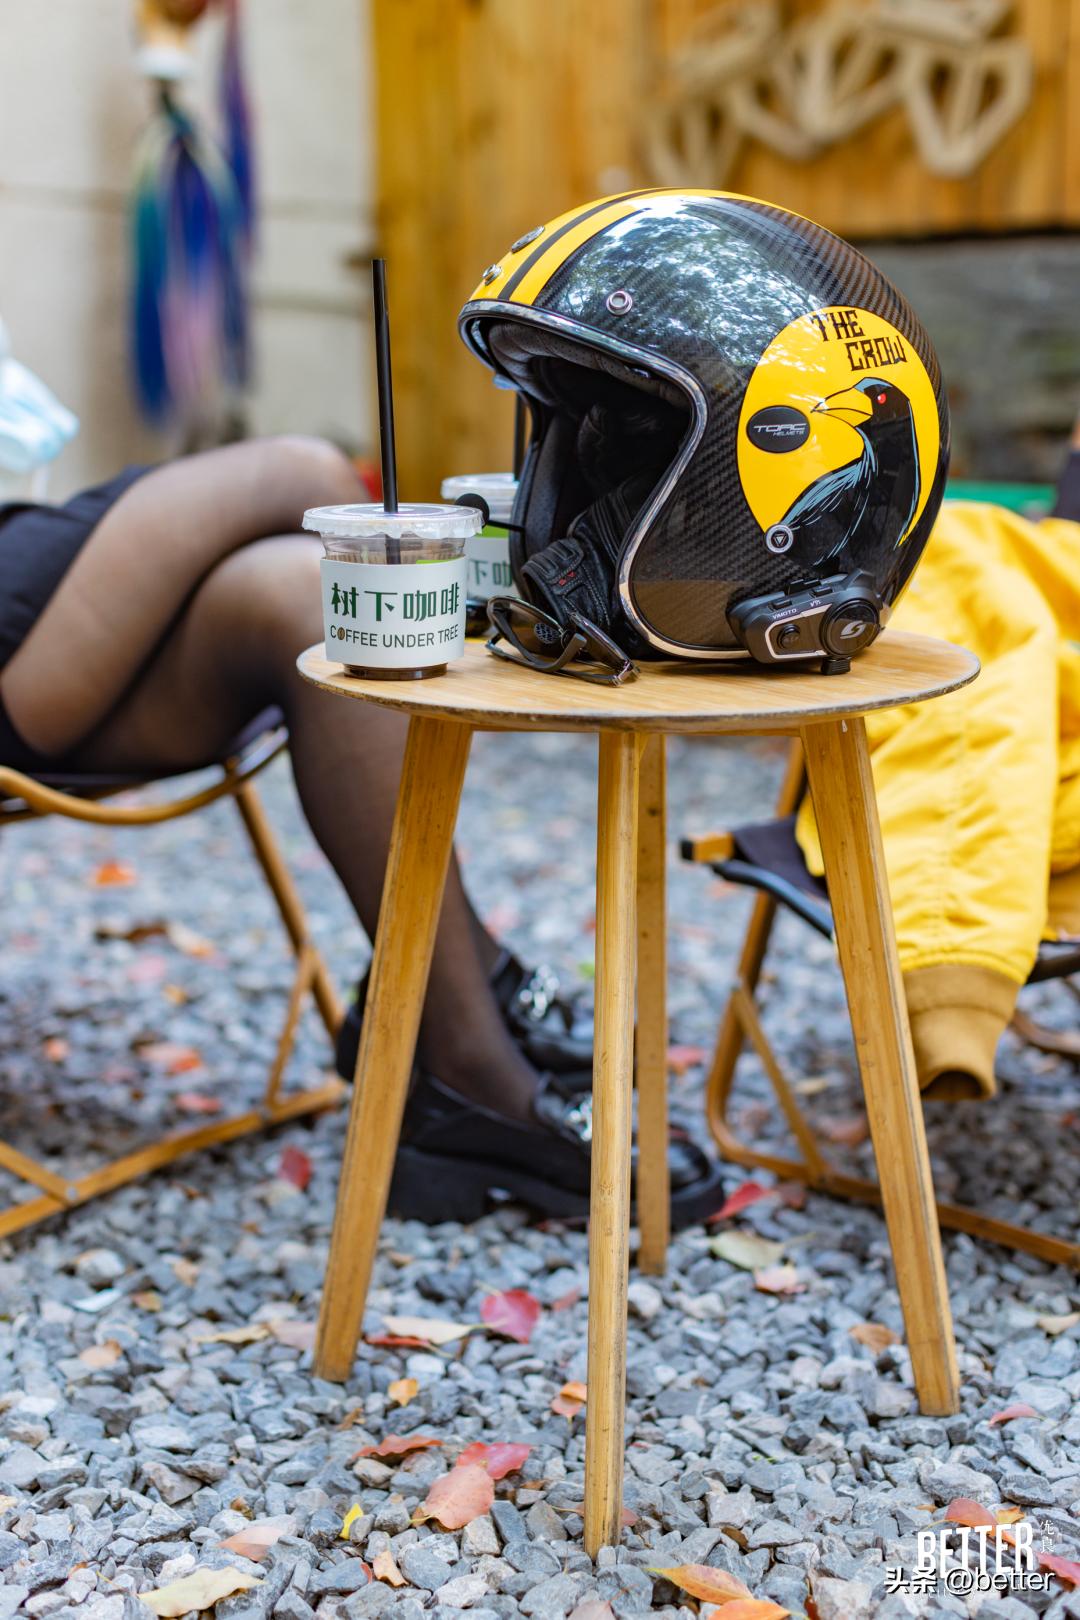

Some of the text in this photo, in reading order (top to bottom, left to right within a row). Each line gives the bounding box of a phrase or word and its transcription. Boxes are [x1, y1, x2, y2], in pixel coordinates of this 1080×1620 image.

[810, 310, 866, 342] THE
[845, 335, 908, 371] CROW
[331, 582, 460, 622] 树下咖啡
[330, 624, 459, 648] COFFEE UNDER TREE
